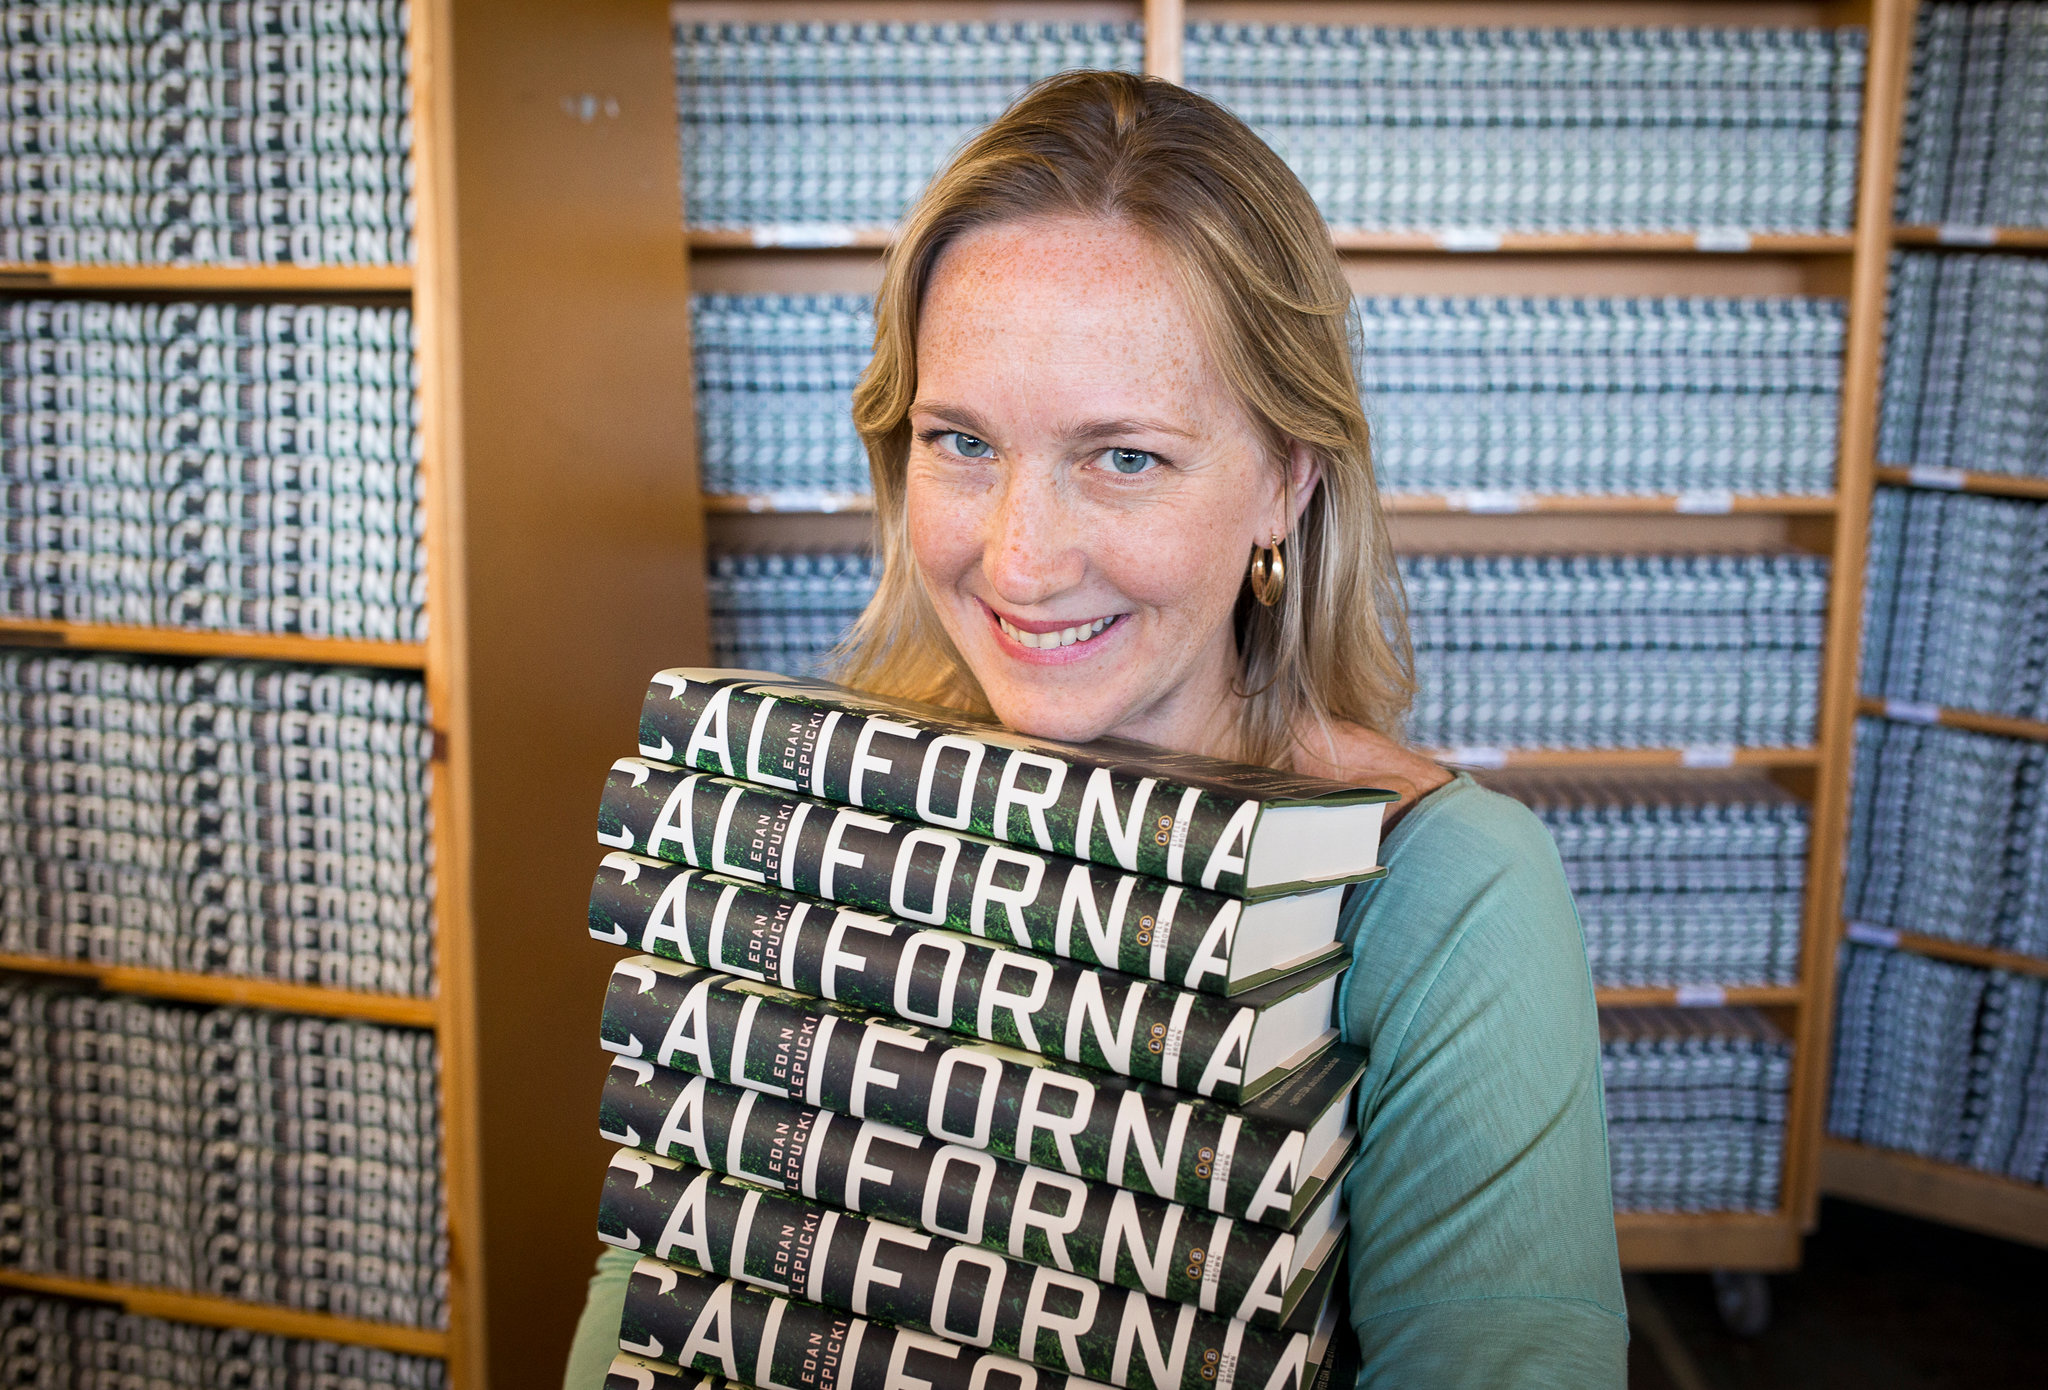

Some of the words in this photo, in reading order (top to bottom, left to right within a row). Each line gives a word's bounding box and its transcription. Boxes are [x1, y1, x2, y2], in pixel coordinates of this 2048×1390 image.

[639, 668, 1259, 890] CALIFORNIA
[783, 723, 802, 770] EDAN
[799, 712, 824, 789] LEPUCKI
[597, 757, 1243, 989] CALIFORNIA
[750, 814, 771, 862] EDAN
[766, 804, 794, 881] LEPUCKI
[588, 852, 1255, 1096] CALIFORNIA
[748, 914, 768, 963] EDAN
[765, 904, 792, 982] LEPUCKI
[599, 959, 1305, 1222] CALIFORNIA
[773, 1027, 795, 1079] EDAN
[791, 1016, 818, 1098] LEPUCKI
[769, 1122, 790, 1173] EDAN
[786, 1111, 814, 1191] LEPUCKI
[599, 1054, 1295, 1322] CALIFORNIA
[774, 1225, 796, 1276] EDAN
[791, 1213, 820, 1294] LEPUCKI
[801, 1332, 823, 1385] EDAN
